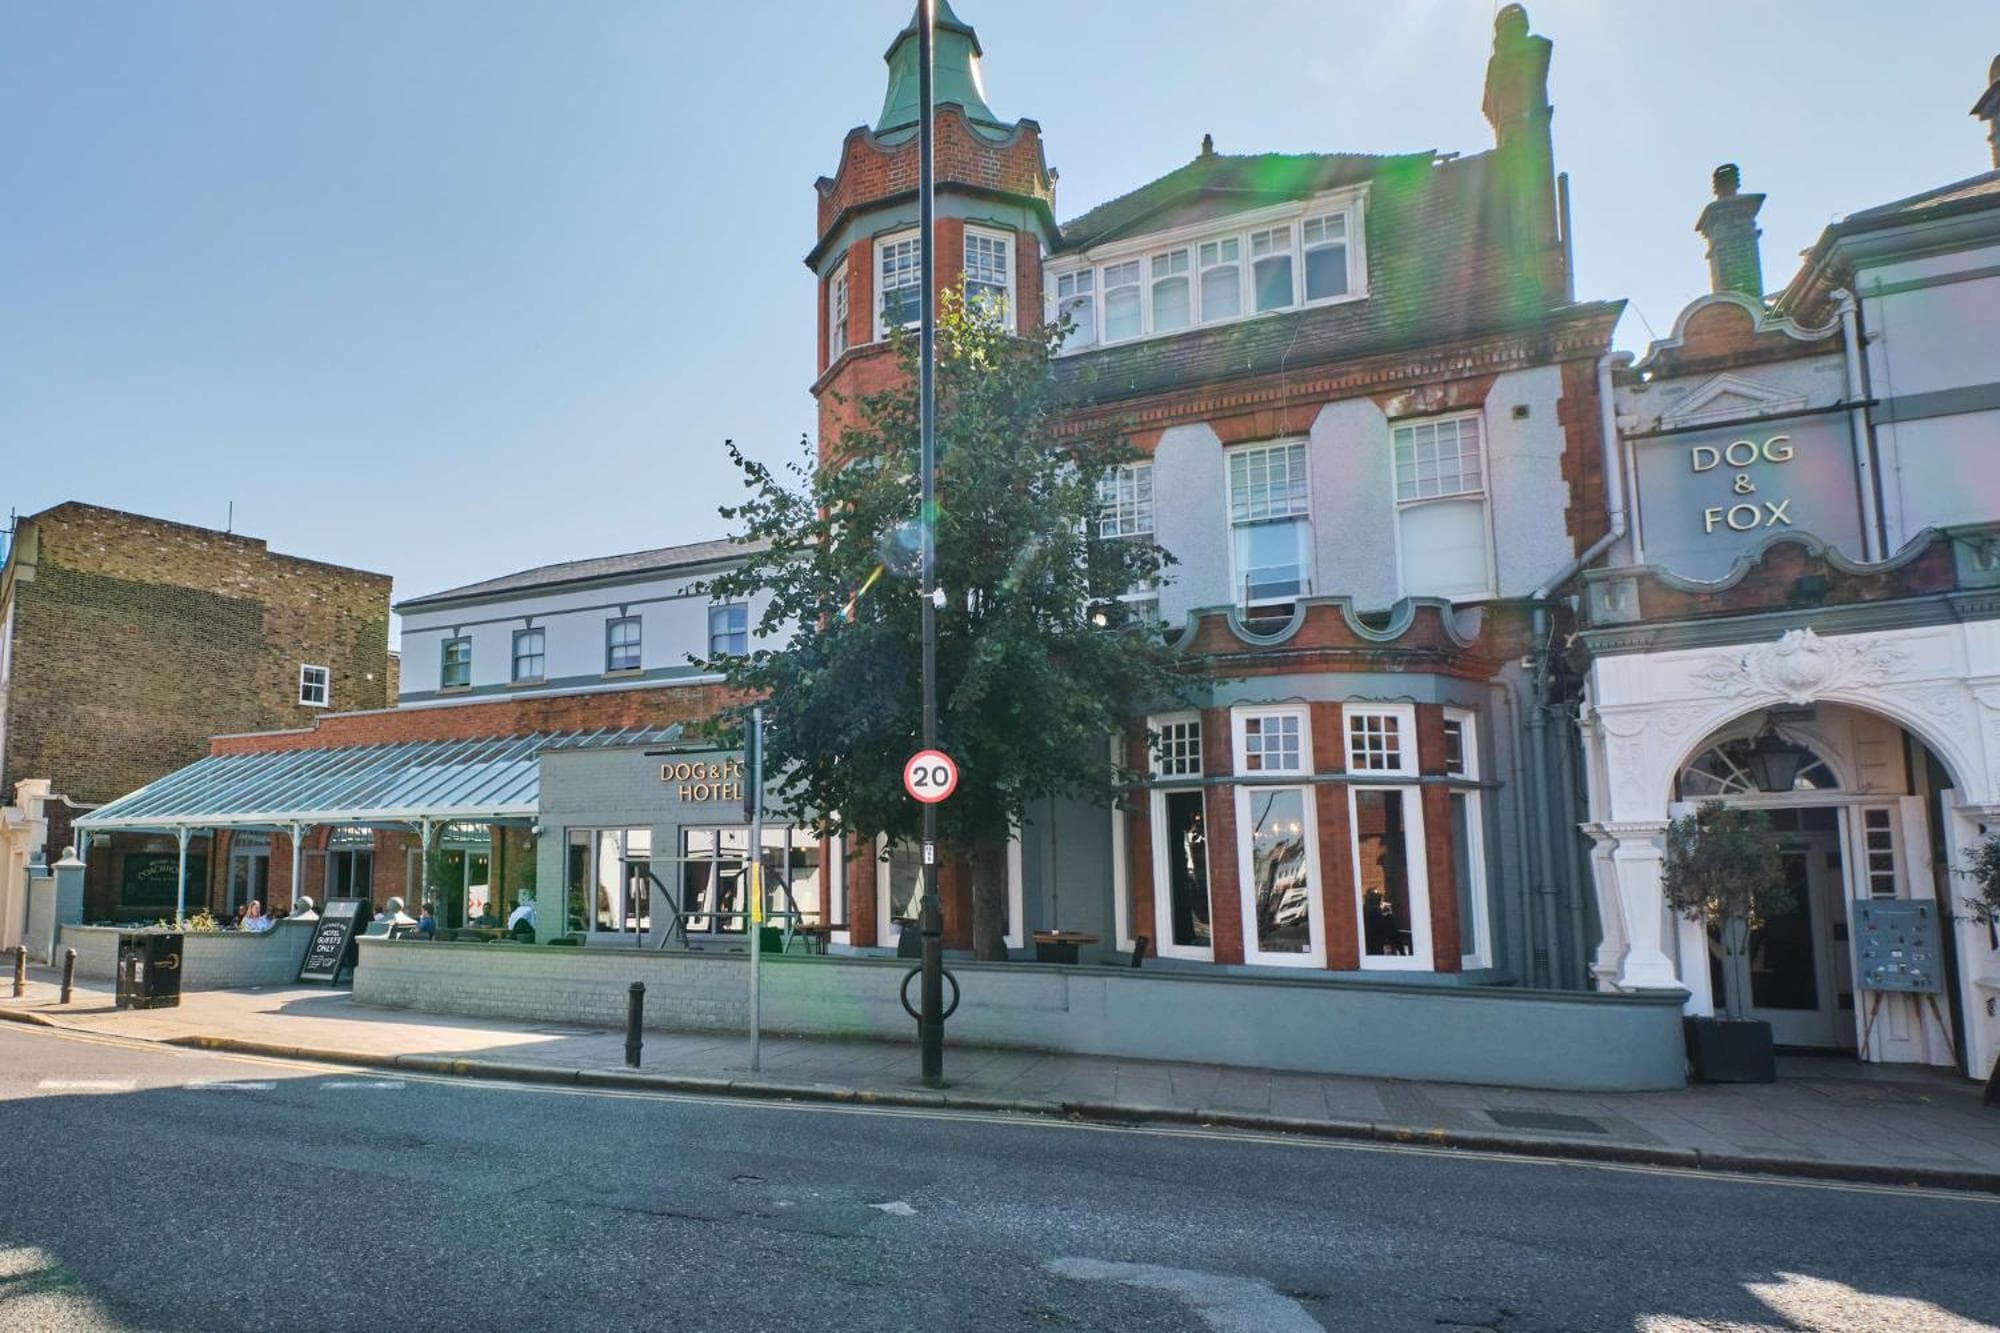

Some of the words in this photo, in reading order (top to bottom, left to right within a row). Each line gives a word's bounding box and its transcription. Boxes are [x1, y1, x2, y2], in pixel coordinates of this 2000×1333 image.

[1692, 435, 1794, 472] DOG
[1734, 473, 1757, 494] &
[1705, 499, 1792, 533] FOX
[660, 762, 706, 781] DOG
[710, 764, 721, 779] &
[723, 760, 745, 779] FO
[913, 766, 949, 787] 20
[679, 783, 744, 801] HOTEL
